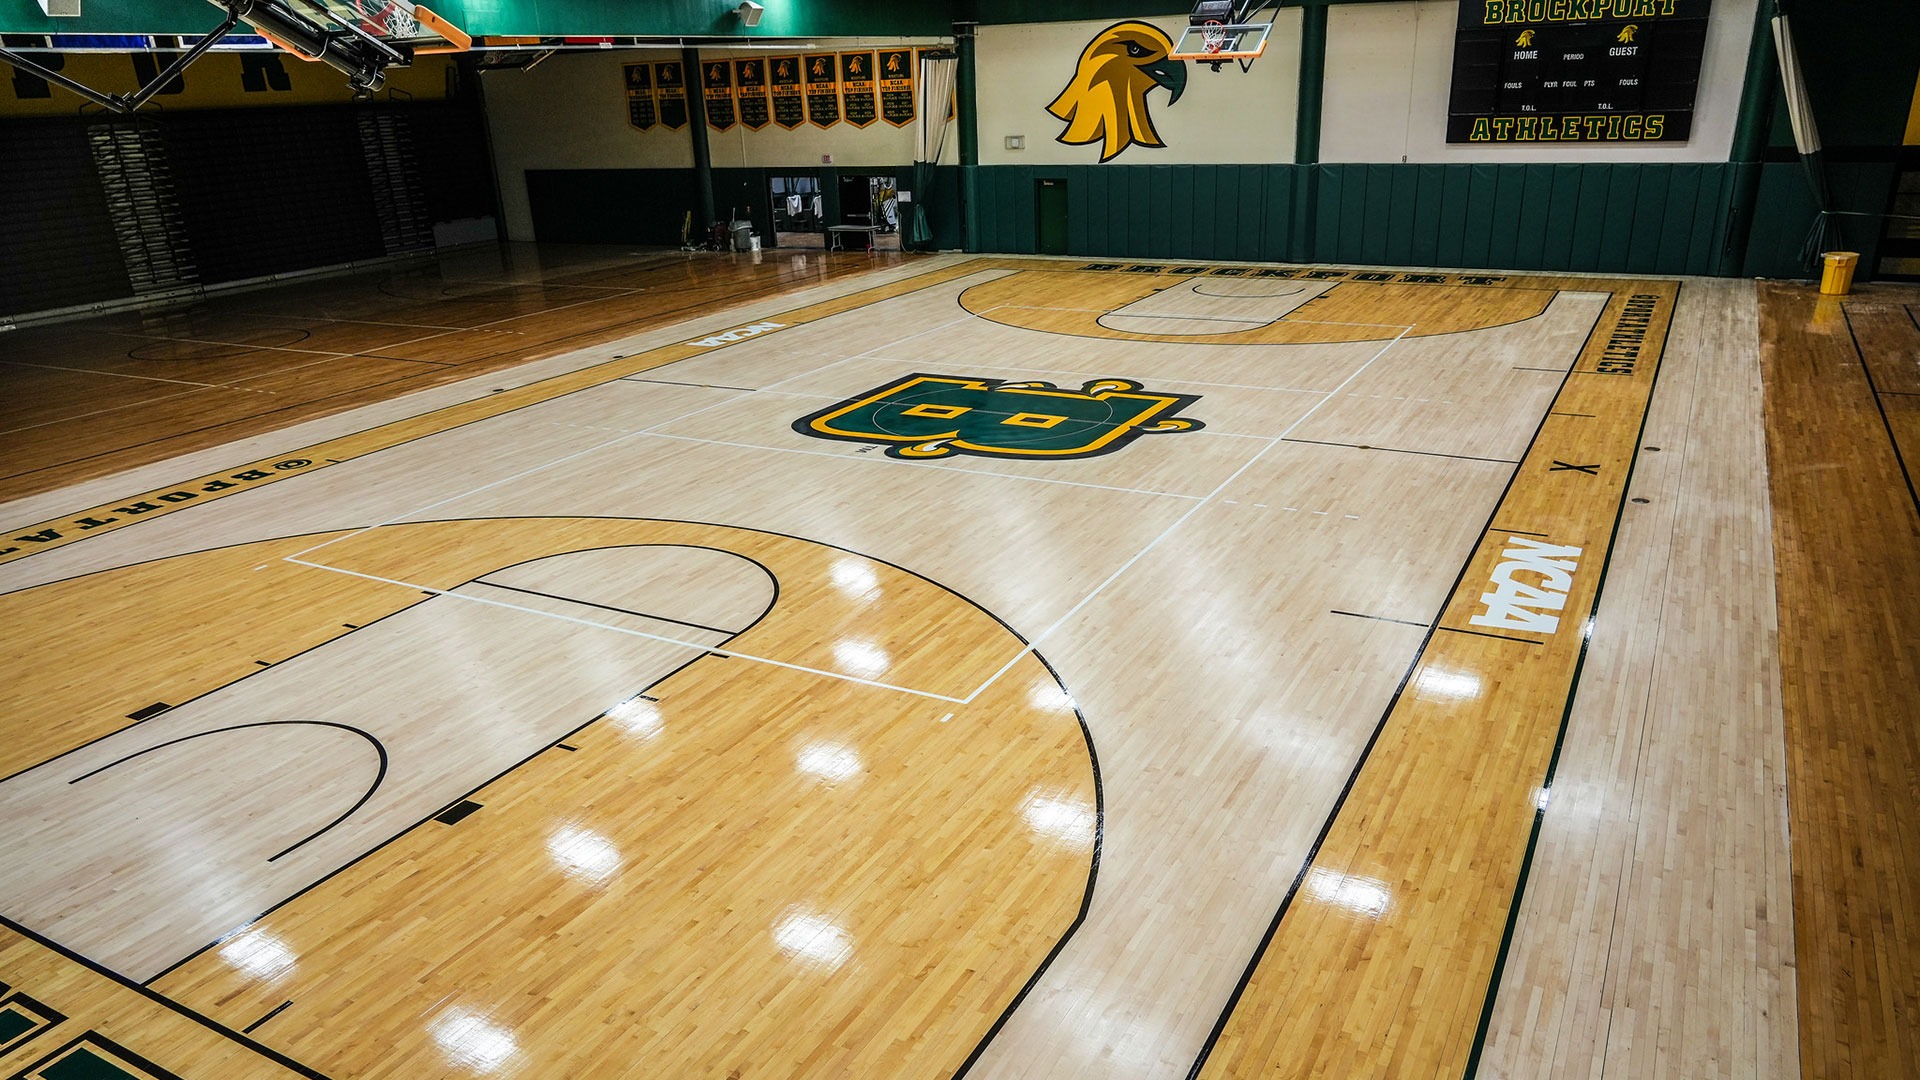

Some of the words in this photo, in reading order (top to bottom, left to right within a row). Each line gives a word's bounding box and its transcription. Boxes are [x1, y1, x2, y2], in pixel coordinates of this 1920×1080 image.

[1484, 0, 1680, 24] BROCKPORT
[1513, 50, 1539, 60] HOME
[1563, 53, 1585, 61] PERIOD
[1608, 46, 1639, 57] GUEST
[1504, 82, 1523, 90] FOULS
[1470, 114, 1665, 141] ATHLETICS
[1080, 262, 1507, 285] BROCKPORT
[687, 321, 787, 347] NCAA
[1469, 536, 1582, 634] NCAA
